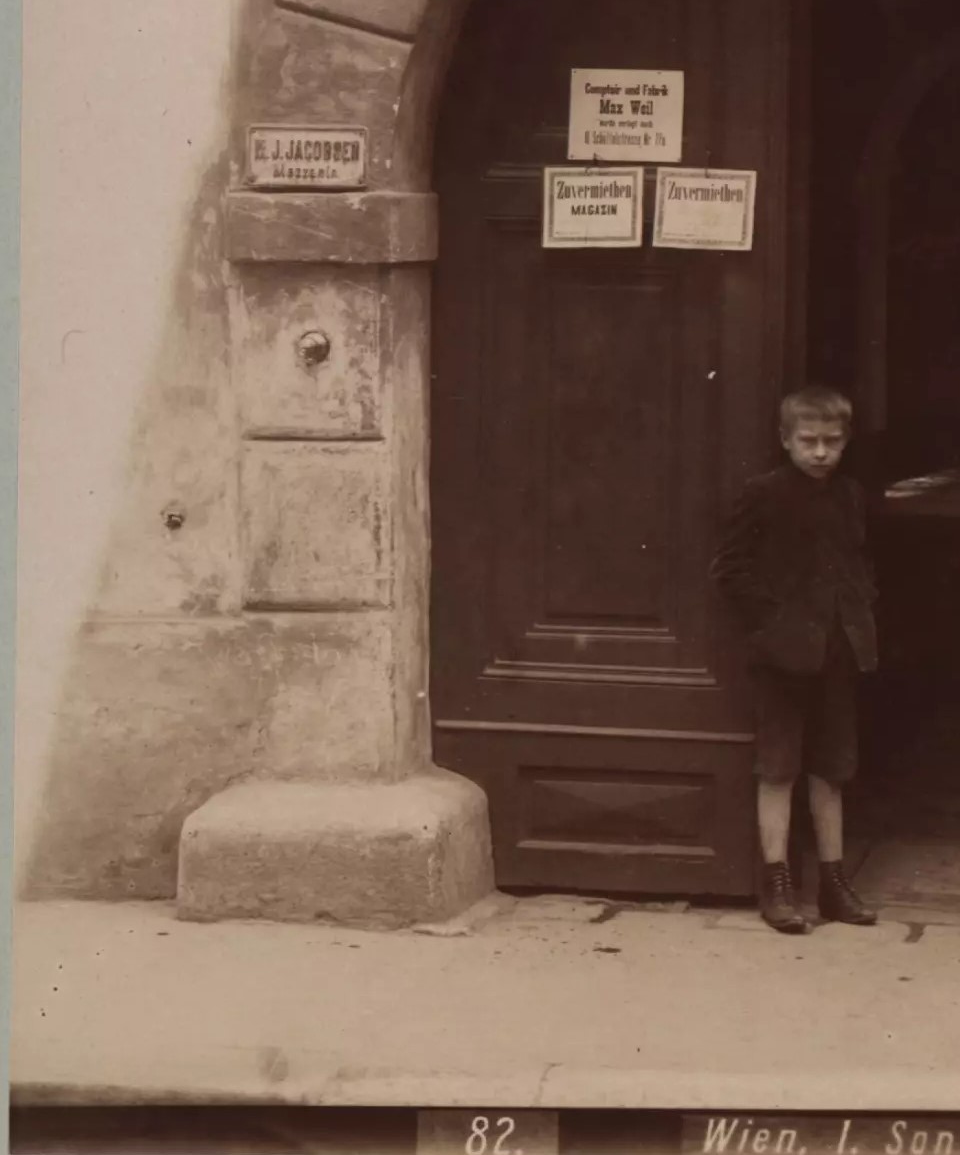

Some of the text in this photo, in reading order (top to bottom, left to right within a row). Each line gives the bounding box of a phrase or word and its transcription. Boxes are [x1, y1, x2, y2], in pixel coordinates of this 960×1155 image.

[600, 99, 653, 115] Max Weil
[570, 204, 618, 216] MAGAZIN
